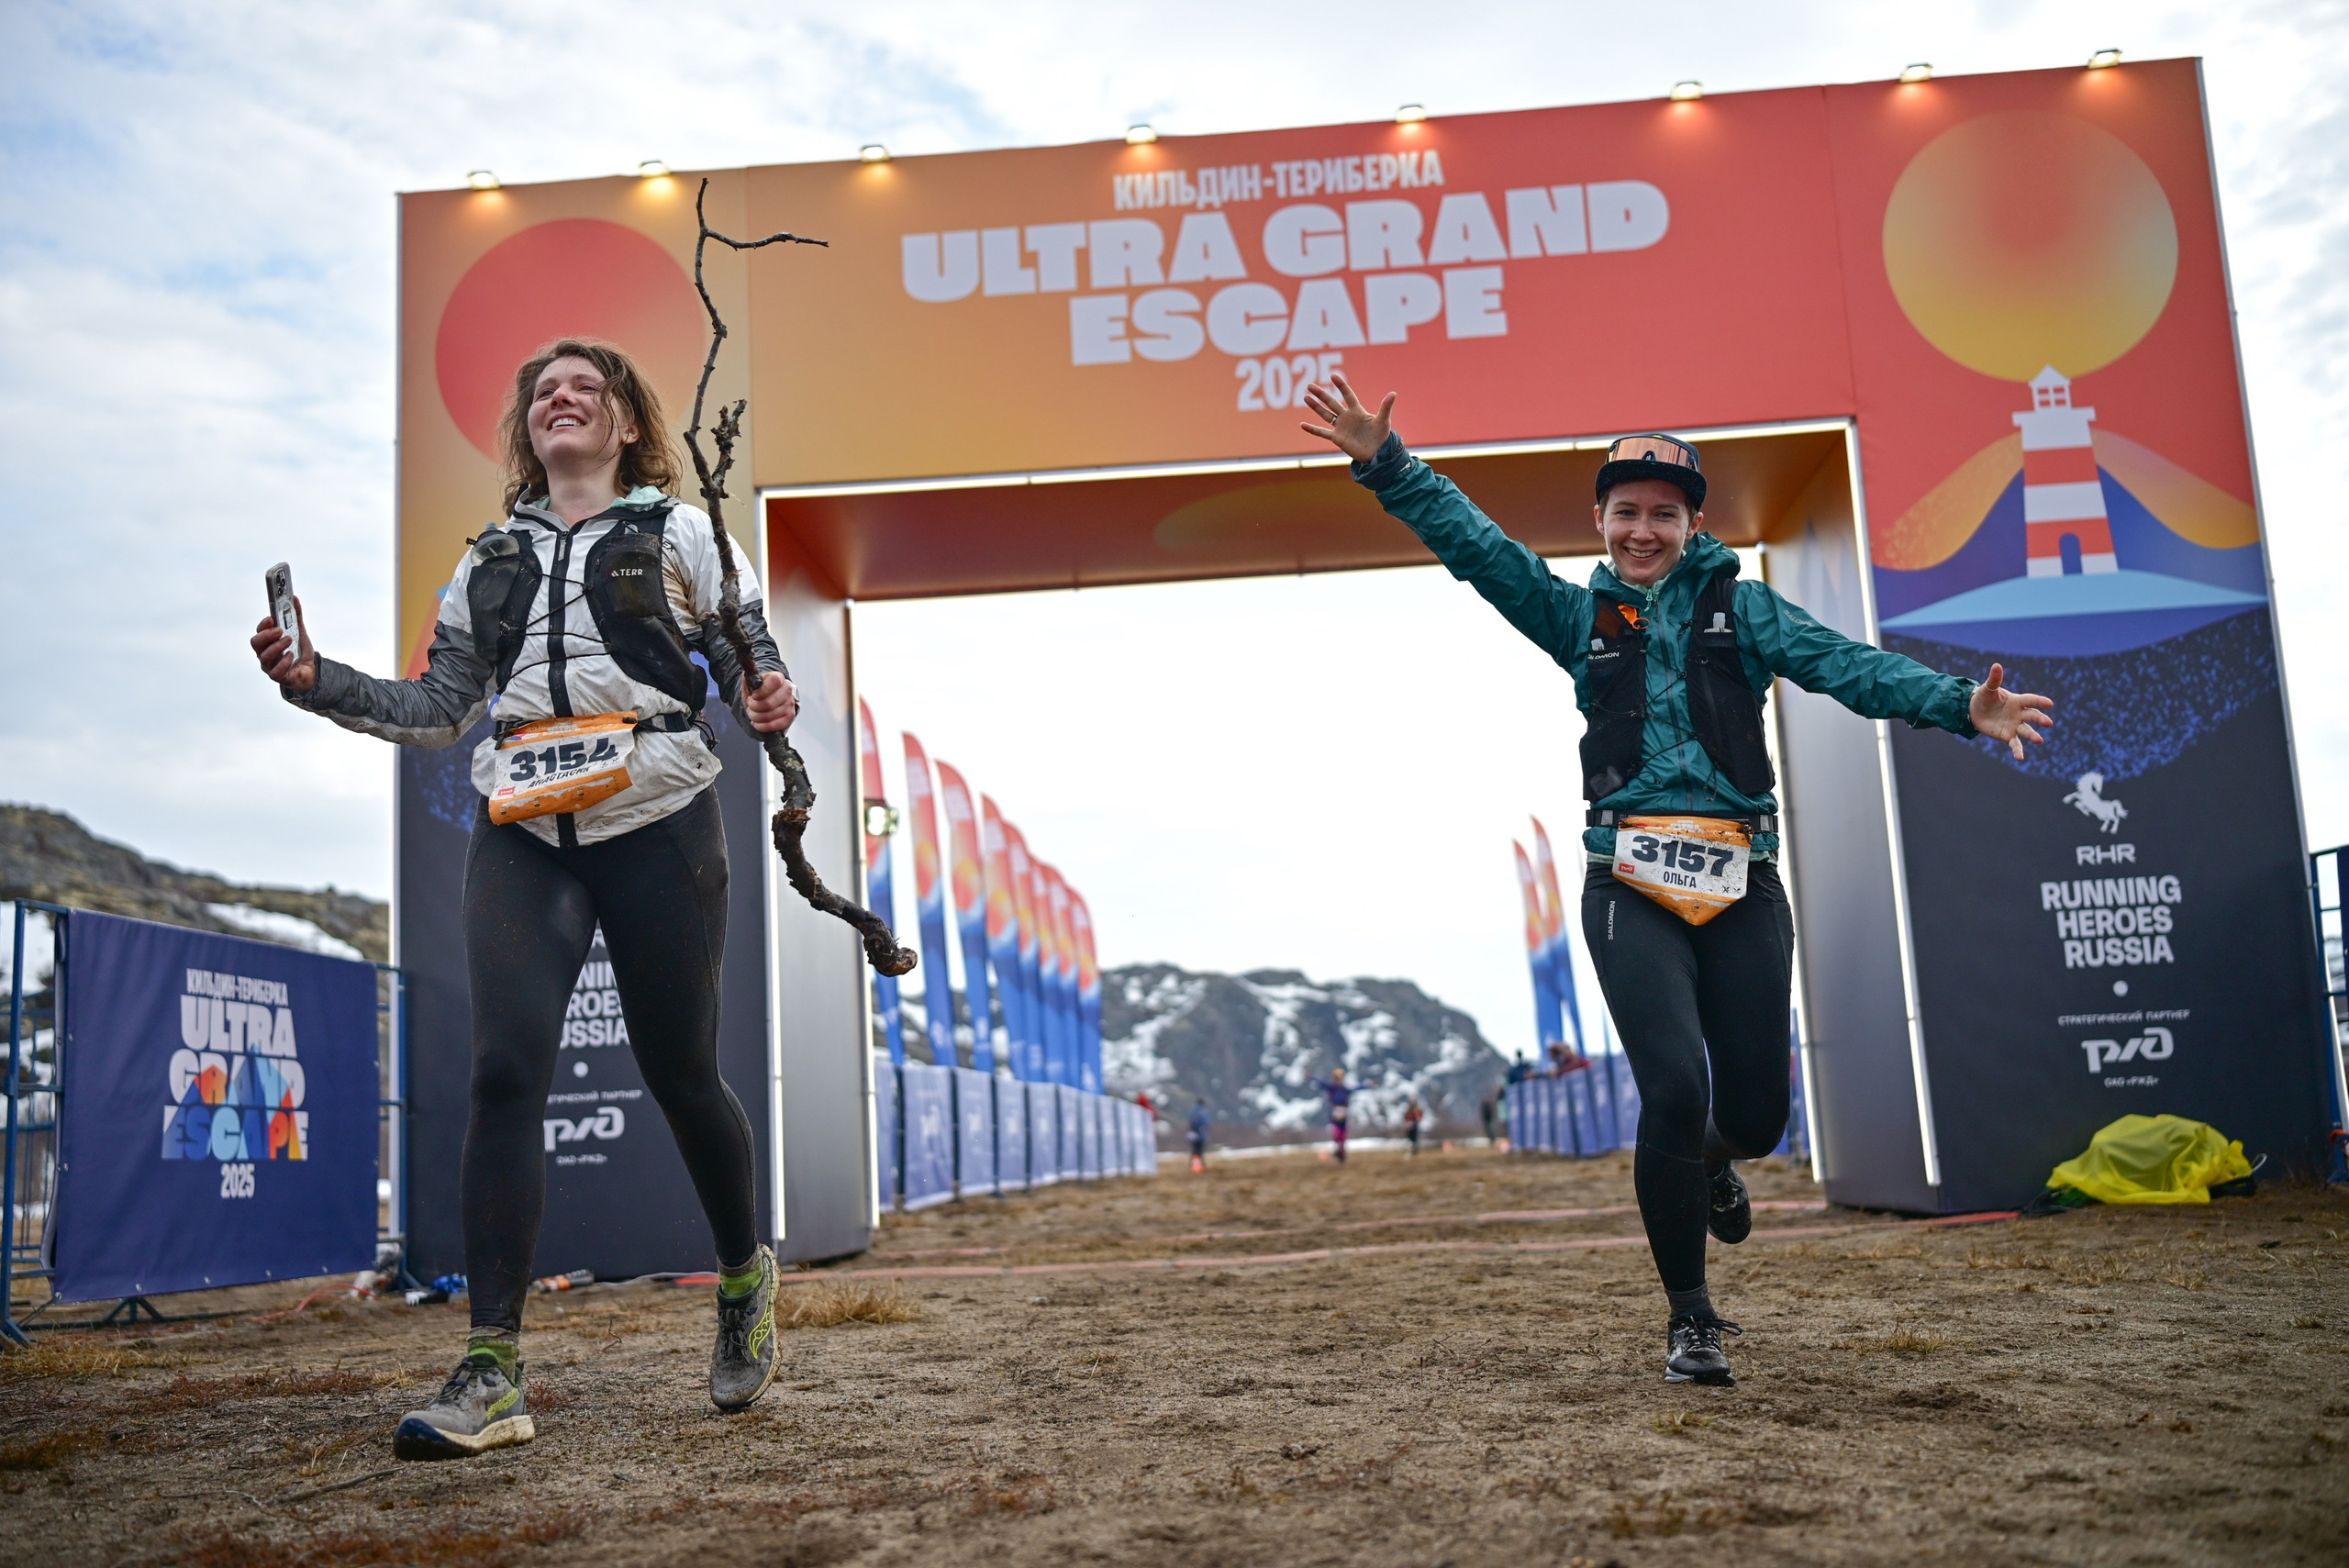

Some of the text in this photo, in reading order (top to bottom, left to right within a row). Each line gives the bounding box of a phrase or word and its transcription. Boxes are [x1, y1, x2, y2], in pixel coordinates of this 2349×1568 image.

[1113, 150, 1444, 210] КИЛЬДИН-ТЕРИБЕРКА
[901, 181, 1670, 303] ULTRA GRAND
[1069, 266, 1508, 366] ESCAPE
[1235, 352, 1346, 411] 2025
[510, 738, 618, 781] 3154
[1631, 835, 1733, 877] 3157
[2076, 843, 2136, 865] RHR
[1663, 872, 1697, 888] ОЛЬГА
[2040, 875, 2182, 911] RUNNING
[1608, 900, 1616, 940] SALOMON
[2055, 906, 2173, 940] HEROES
[2064, 935, 2175, 969] RUSSIA
[186, 968, 288, 1006] КИЛЬДИН-ТЕРИБЕРКА
[565, 988, 623, 1019] ROE
[181, 995, 297, 1058] ULTRA
[560, 1018, 629, 1049] USSIA
[2145, 1008, 2190, 1022] ПАРТНЕР
[169, 1049, 306, 1109] GRAND
[161, 1105, 308, 1161] ESCAPE
[220, 1162, 255, 1198] 2025
